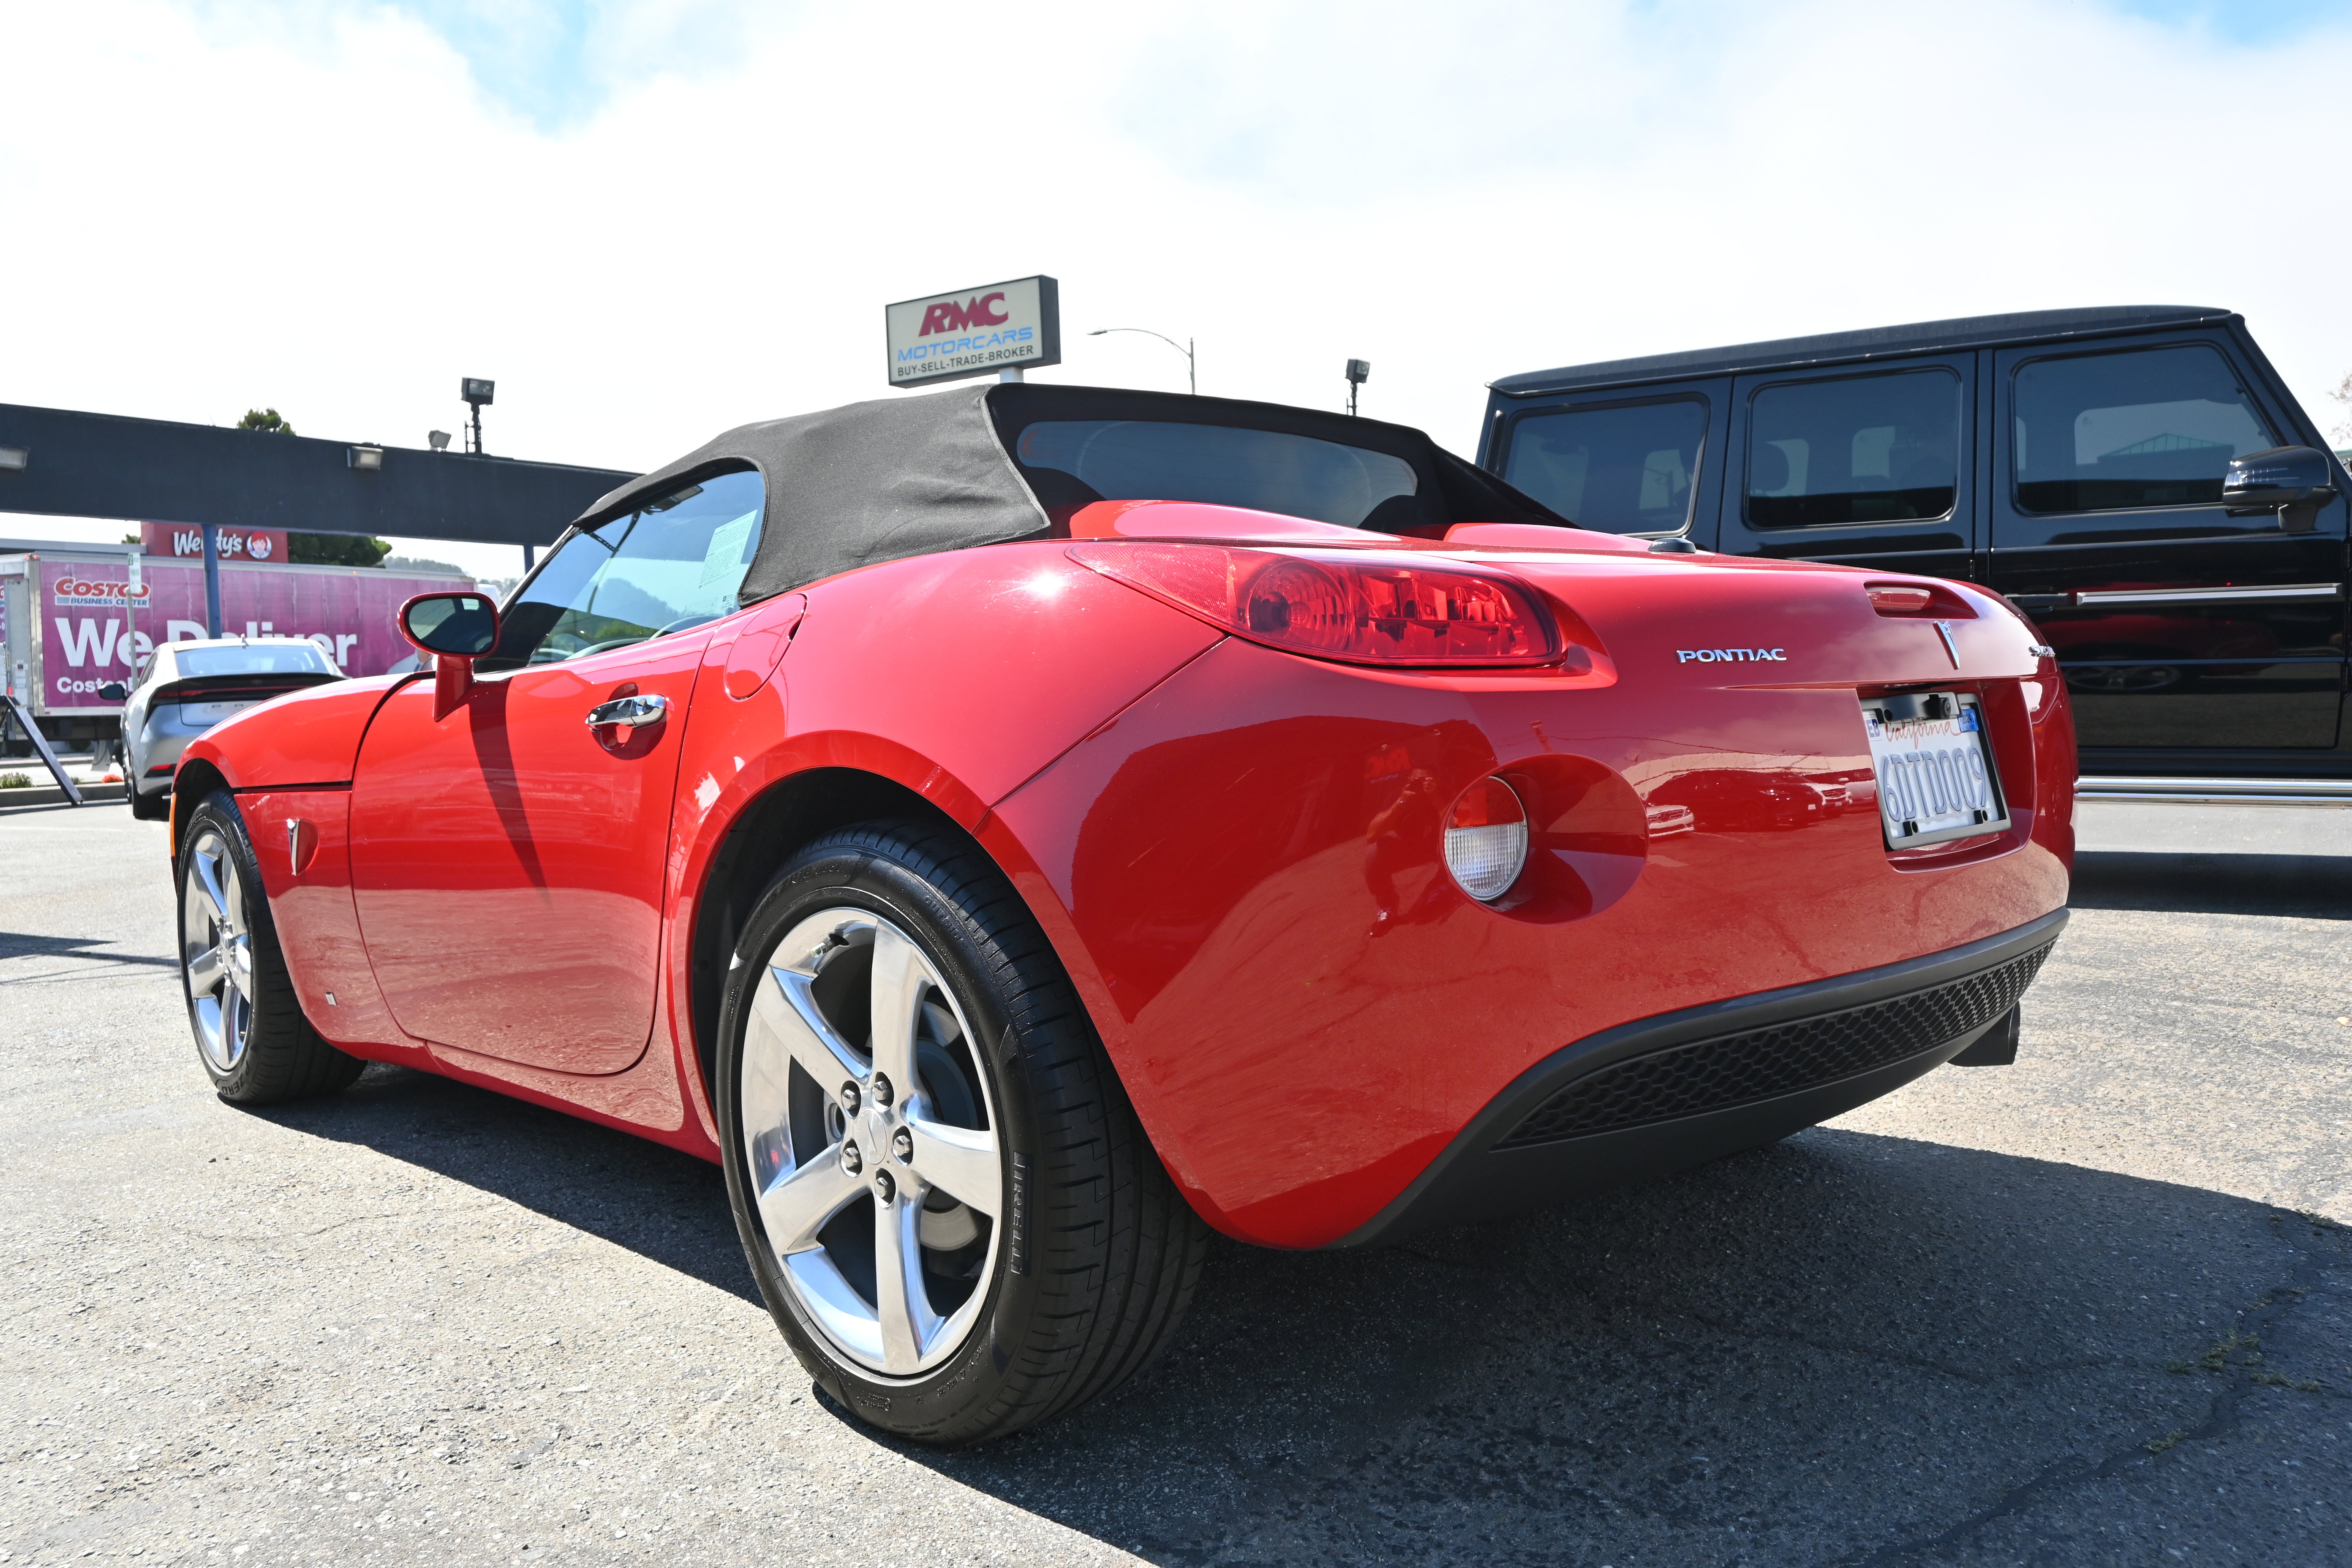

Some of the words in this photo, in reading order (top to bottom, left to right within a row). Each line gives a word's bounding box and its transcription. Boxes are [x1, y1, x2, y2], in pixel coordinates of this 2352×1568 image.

[918, 291, 1009, 337] RMC
[897, 326, 1033, 362] MOTORCARS
[897, 345, 1034, 376] BUY-SELL-TRADE-BROKER
[173, 528, 242, 558] Wedy's
[54, 618, 154, 668] We
[1676, 648, 1787, 664] PONTIAC
[1883, 747, 1986, 822] 6DTD009
